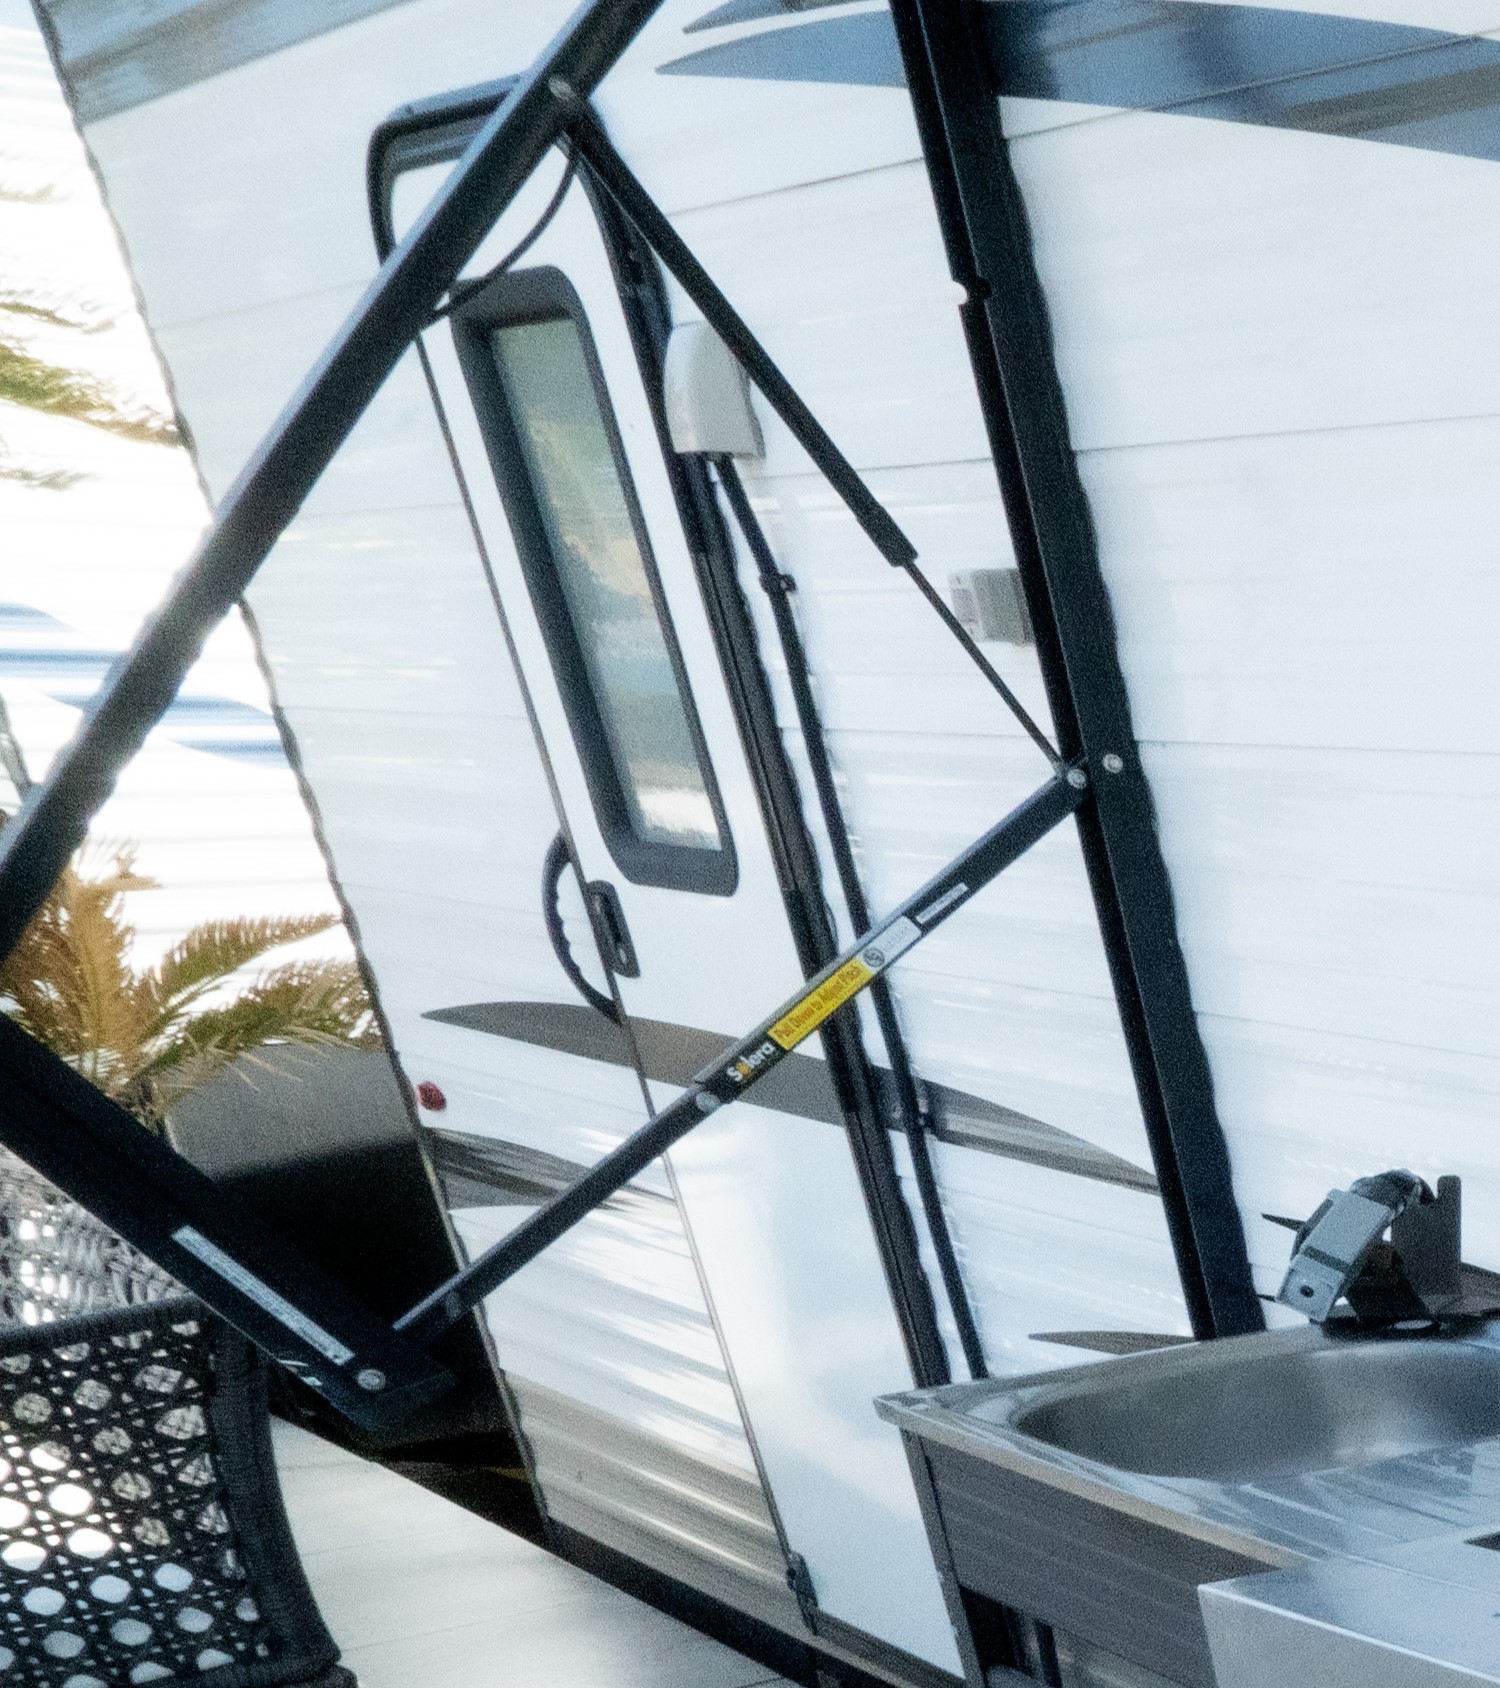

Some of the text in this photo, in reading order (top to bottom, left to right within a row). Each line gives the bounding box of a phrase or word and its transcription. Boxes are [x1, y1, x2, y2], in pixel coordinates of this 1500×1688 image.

[772, 961, 863, 1043] Pull Down to Adjust Pitch
